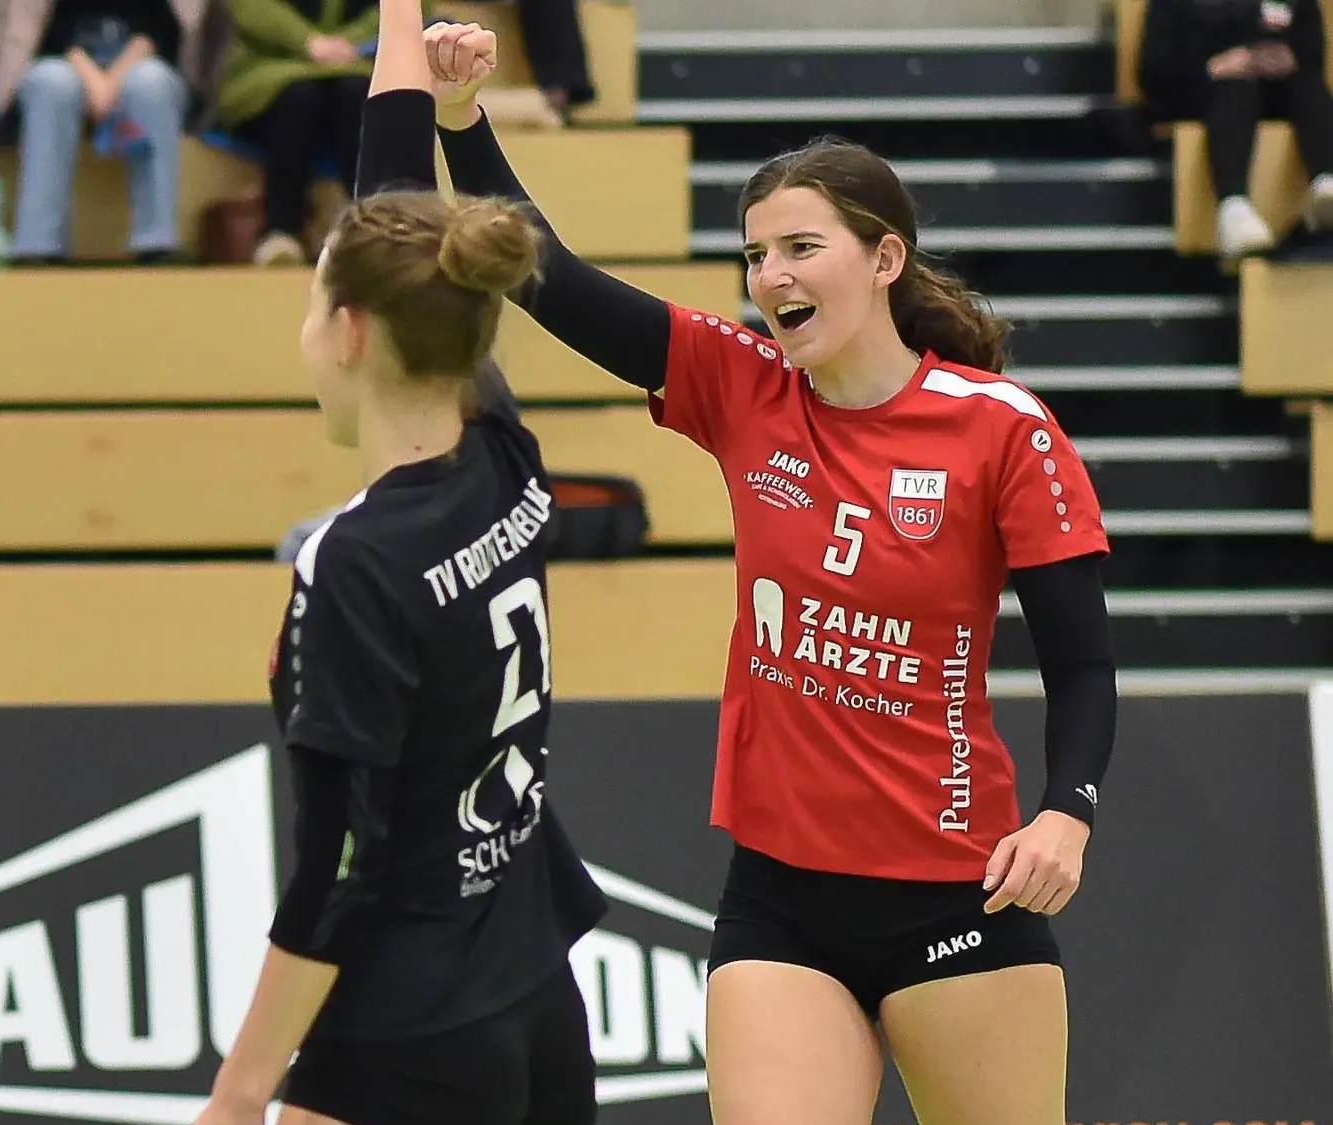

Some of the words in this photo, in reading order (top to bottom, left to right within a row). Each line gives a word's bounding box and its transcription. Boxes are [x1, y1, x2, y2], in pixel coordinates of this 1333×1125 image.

[768, 450, 810, 478] JAKO
[901, 477, 938, 494] TVR
[896, 506, 936, 525] 1861
[822, 501, 872, 576] 5
[423, 558, 459, 606] TV
[798, 597, 912, 647] ZAHN
[793, 628, 921, 684] ÄRZTE
[802, 676, 828, 701] Dr.
[835, 685, 914, 717] Kocher
[938, 624, 973, 833] Pulvermüller
[927, 930, 982, 963] JAKO
